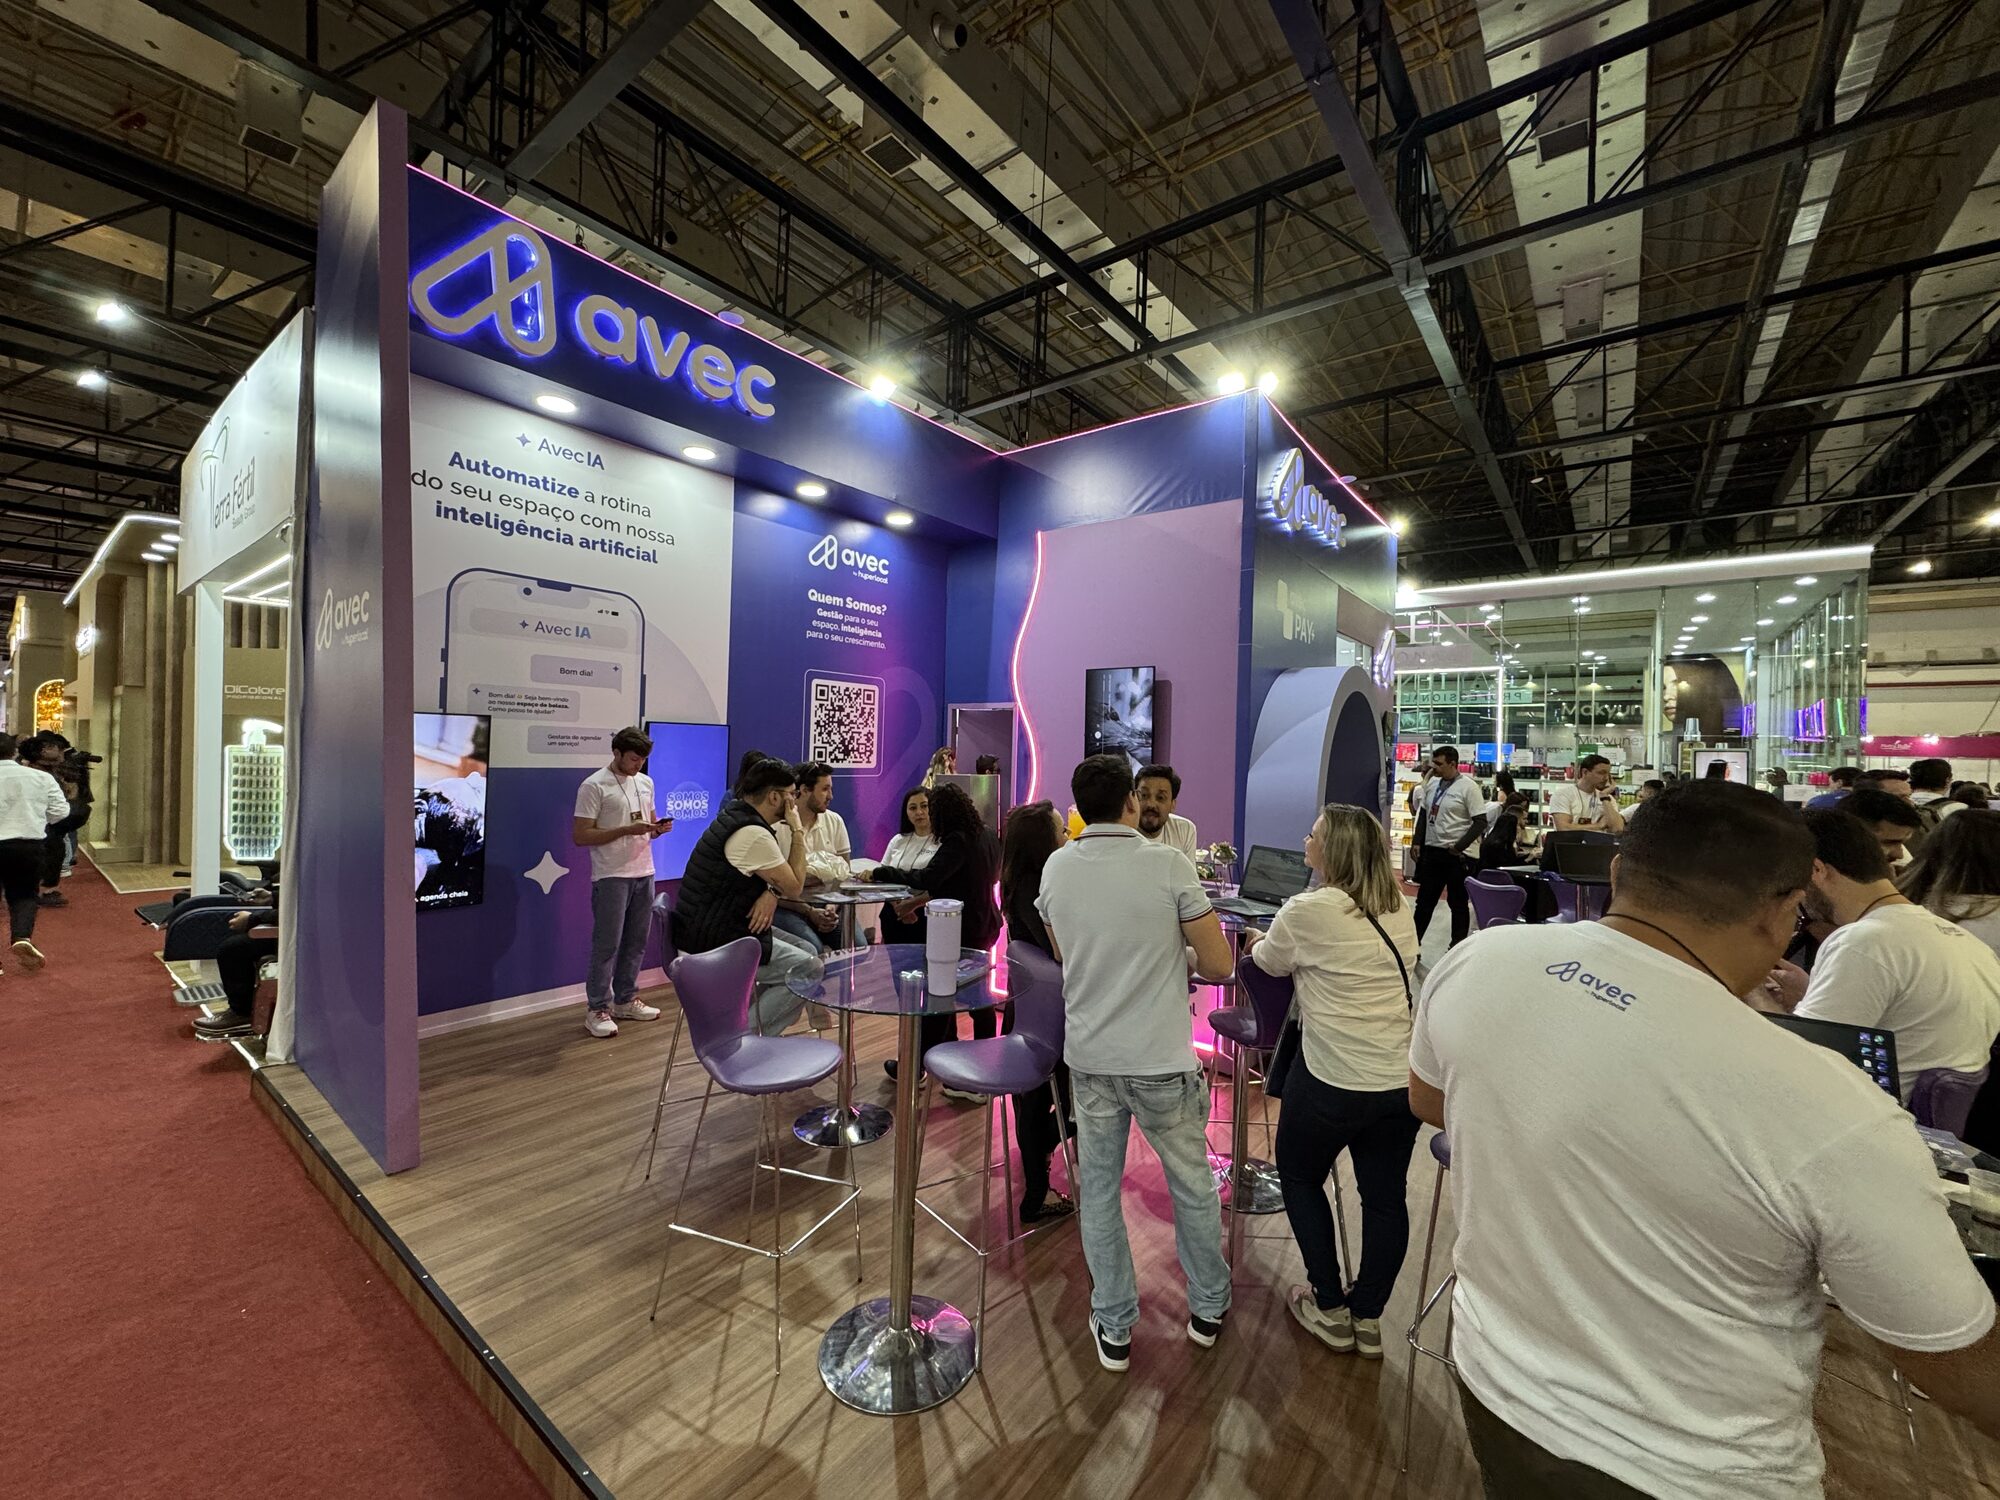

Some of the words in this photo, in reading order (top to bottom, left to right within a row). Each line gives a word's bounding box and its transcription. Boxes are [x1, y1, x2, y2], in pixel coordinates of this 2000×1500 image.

[575, 294, 776, 417] avec
[448, 451, 580, 499] Automatize
[585, 490, 596, 503] a
[601, 493, 652, 518] rotina
[411, 469, 443, 490] do
[450, 481, 492, 503] seu
[499, 492, 575, 522] espaço
[580, 514, 621, 533] com
[626, 525, 675, 546] nossa
[435, 500, 574, 546] inteligência
[579, 536, 658, 564] artificial
[841, 548, 889, 575] avec
[334, 591, 370, 630] avec
[808, 588, 844, 607] Quem
[845, 597, 887, 616] Somos?
[817, 608, 844, 620] Gestão
[844, 615, 860, 625] para
[867, 619, 879, 627] seu
[534, 620, 572, 638] Avec
[575, 626, 592, 640] IA
[806, 630, 823, 639] para
[831, 635, 844, 643] seu
[844, 637, 886, 649] crescimento.
[841, 624, 882, 638] inteligência
[559, 667, 579, 676] Bom
[580, 669, 593, 677] dia!
[666, 800, 708, 811] SOMOS
[667, 790, 709, 801] SOMOS
[666, 809, 708, 820] SOMOS
[420, 891, 448, 901] agenda
[449, 890, 468, 898] cheia
[1579, 973, 1637, 1006] avec
